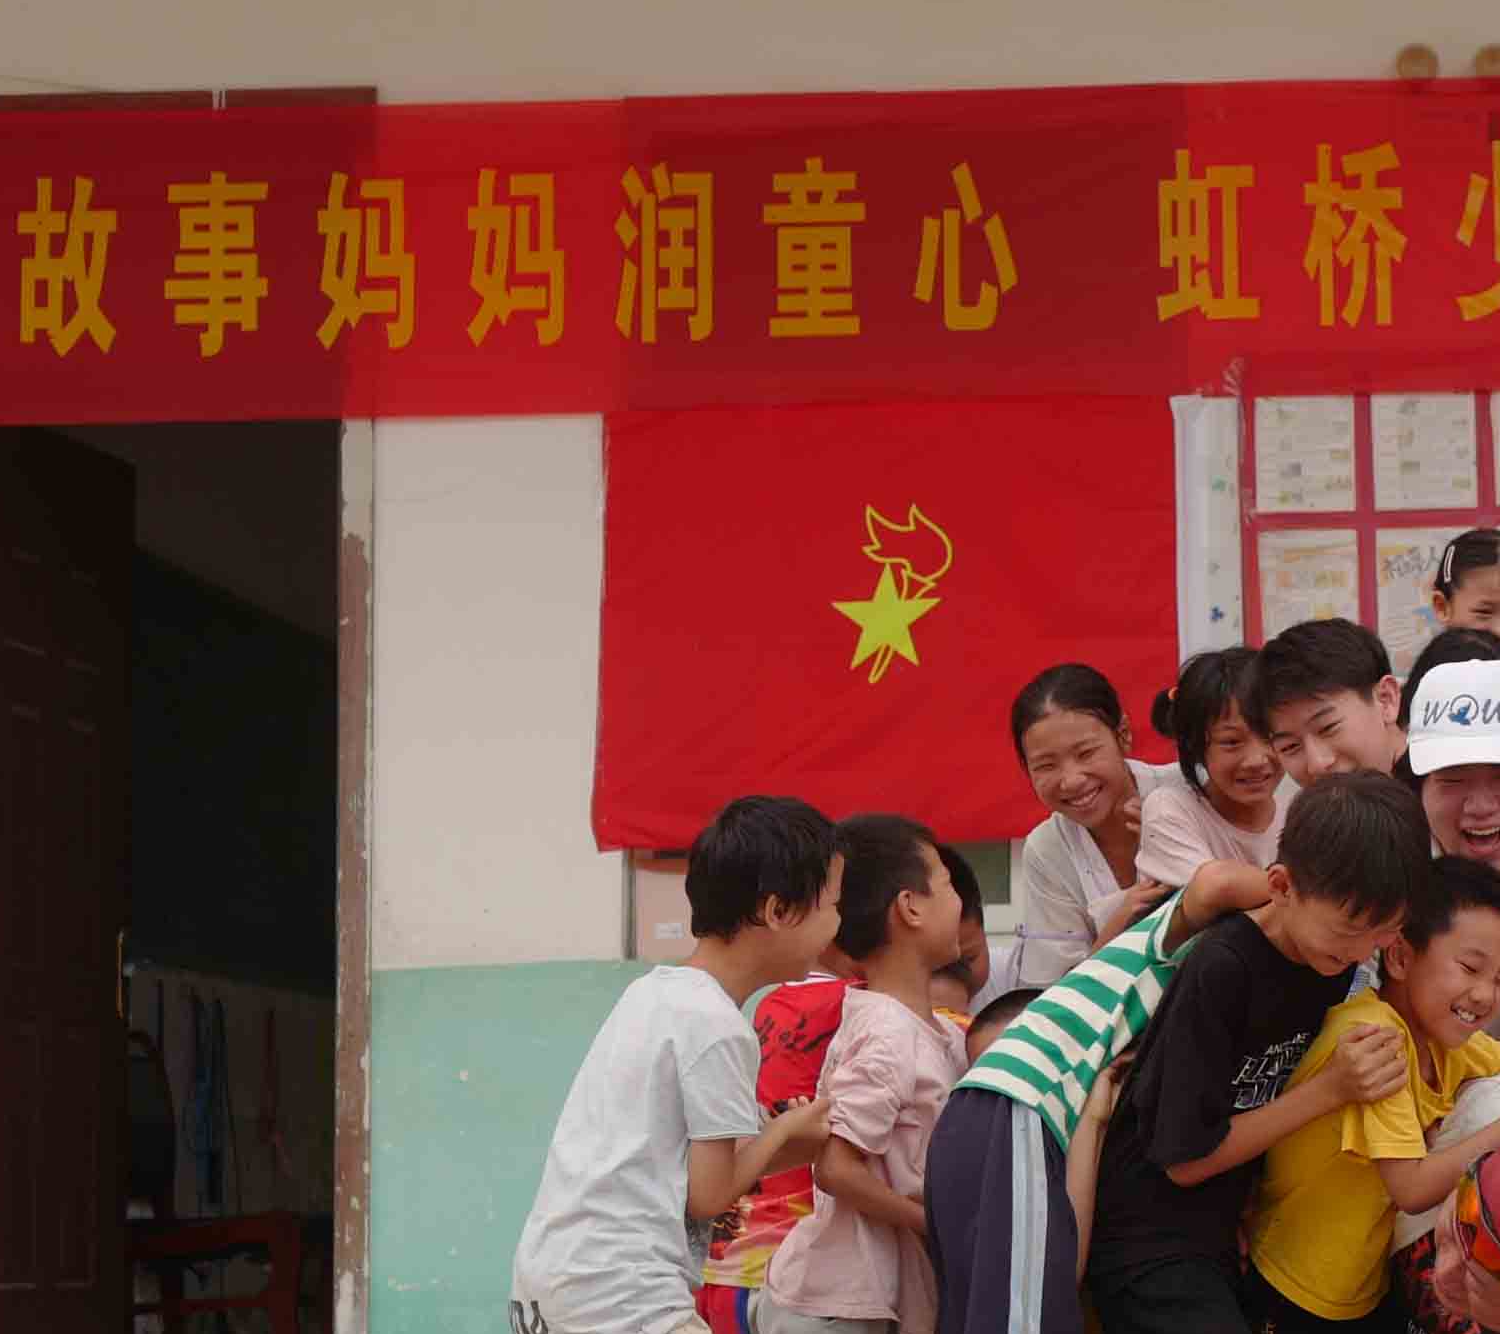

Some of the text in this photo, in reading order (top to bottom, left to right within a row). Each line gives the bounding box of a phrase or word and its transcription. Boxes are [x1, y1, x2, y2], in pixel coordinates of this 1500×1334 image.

[17, 157, 1019, 358] 故事妈妈润童心
